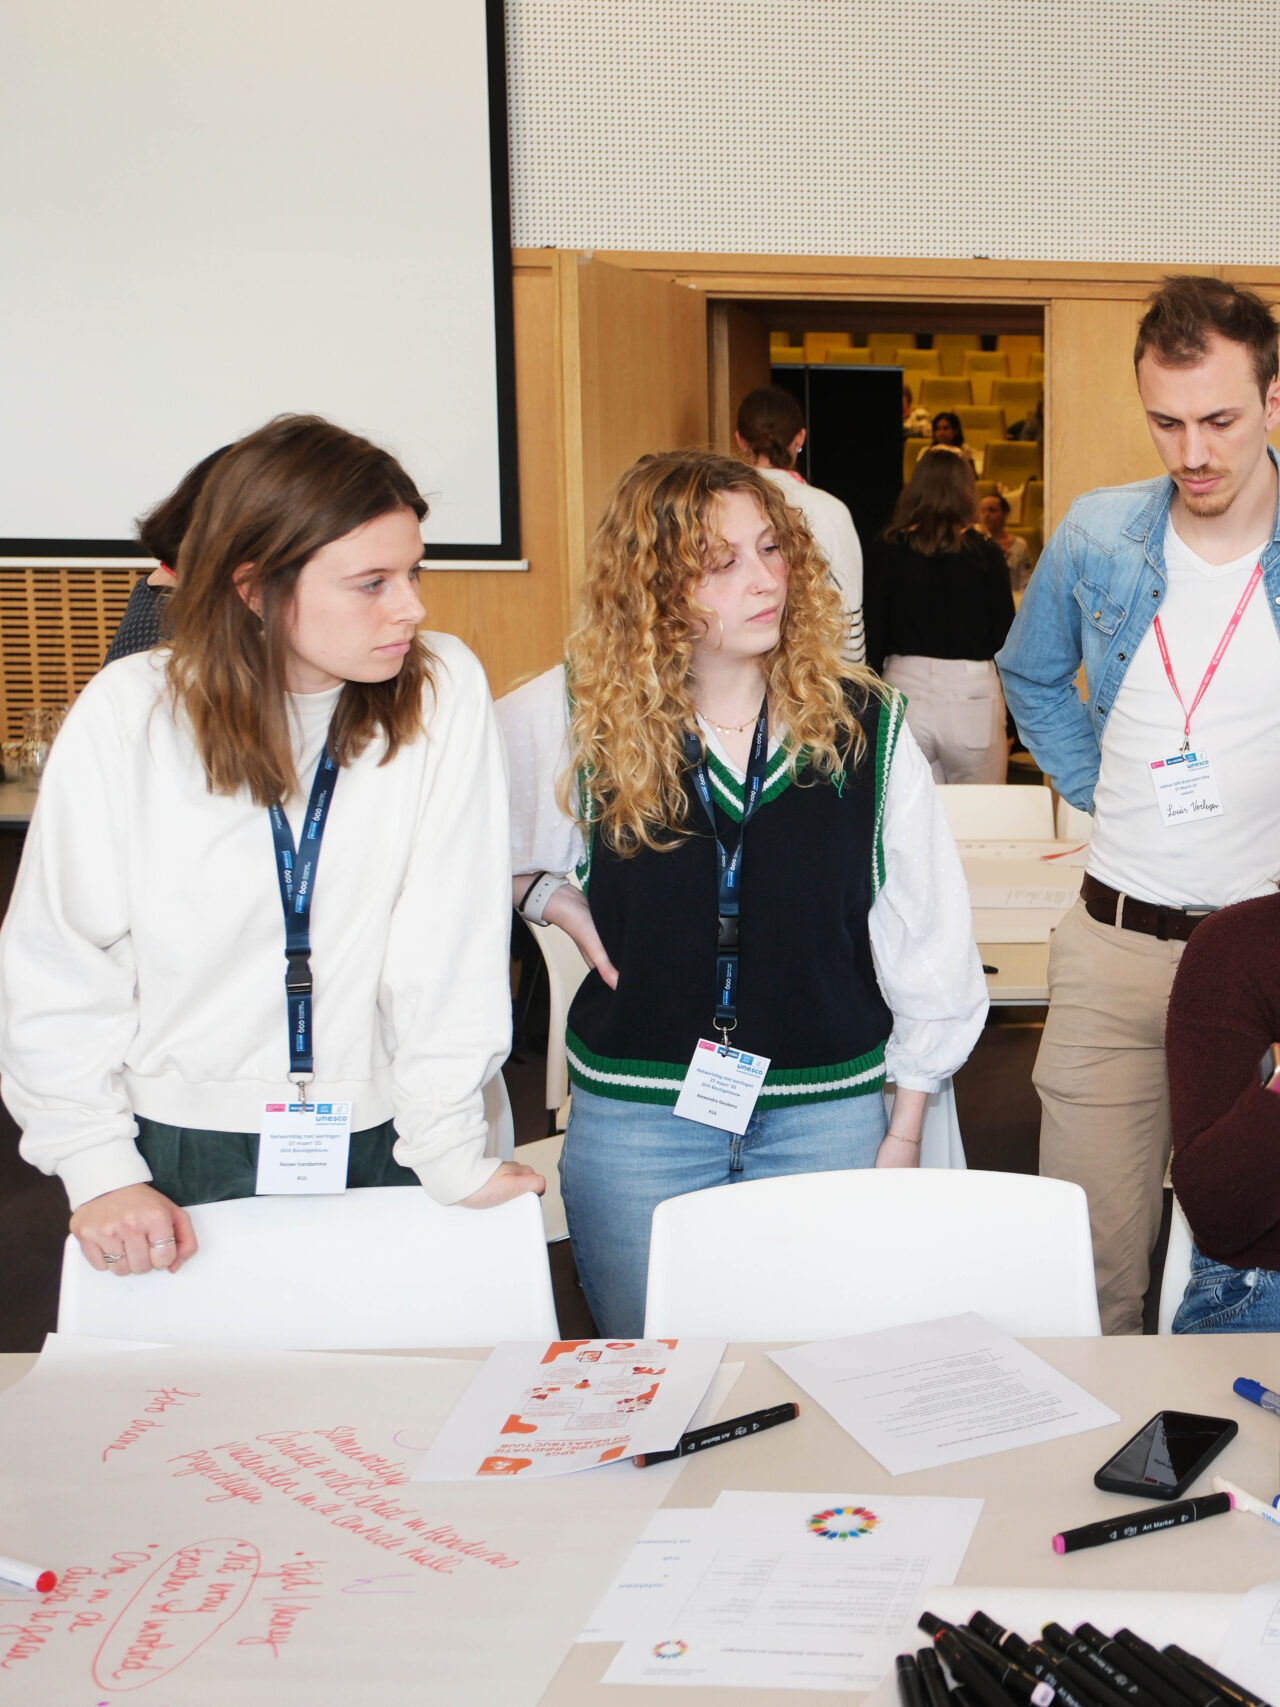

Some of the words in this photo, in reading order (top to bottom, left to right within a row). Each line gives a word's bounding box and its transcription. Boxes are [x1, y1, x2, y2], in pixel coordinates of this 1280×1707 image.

[737, 1063, 763, 1075] unesco
[1142, 1523, 1152, 1532] Art
[1153, 1518, 1175, 1528] Marker
